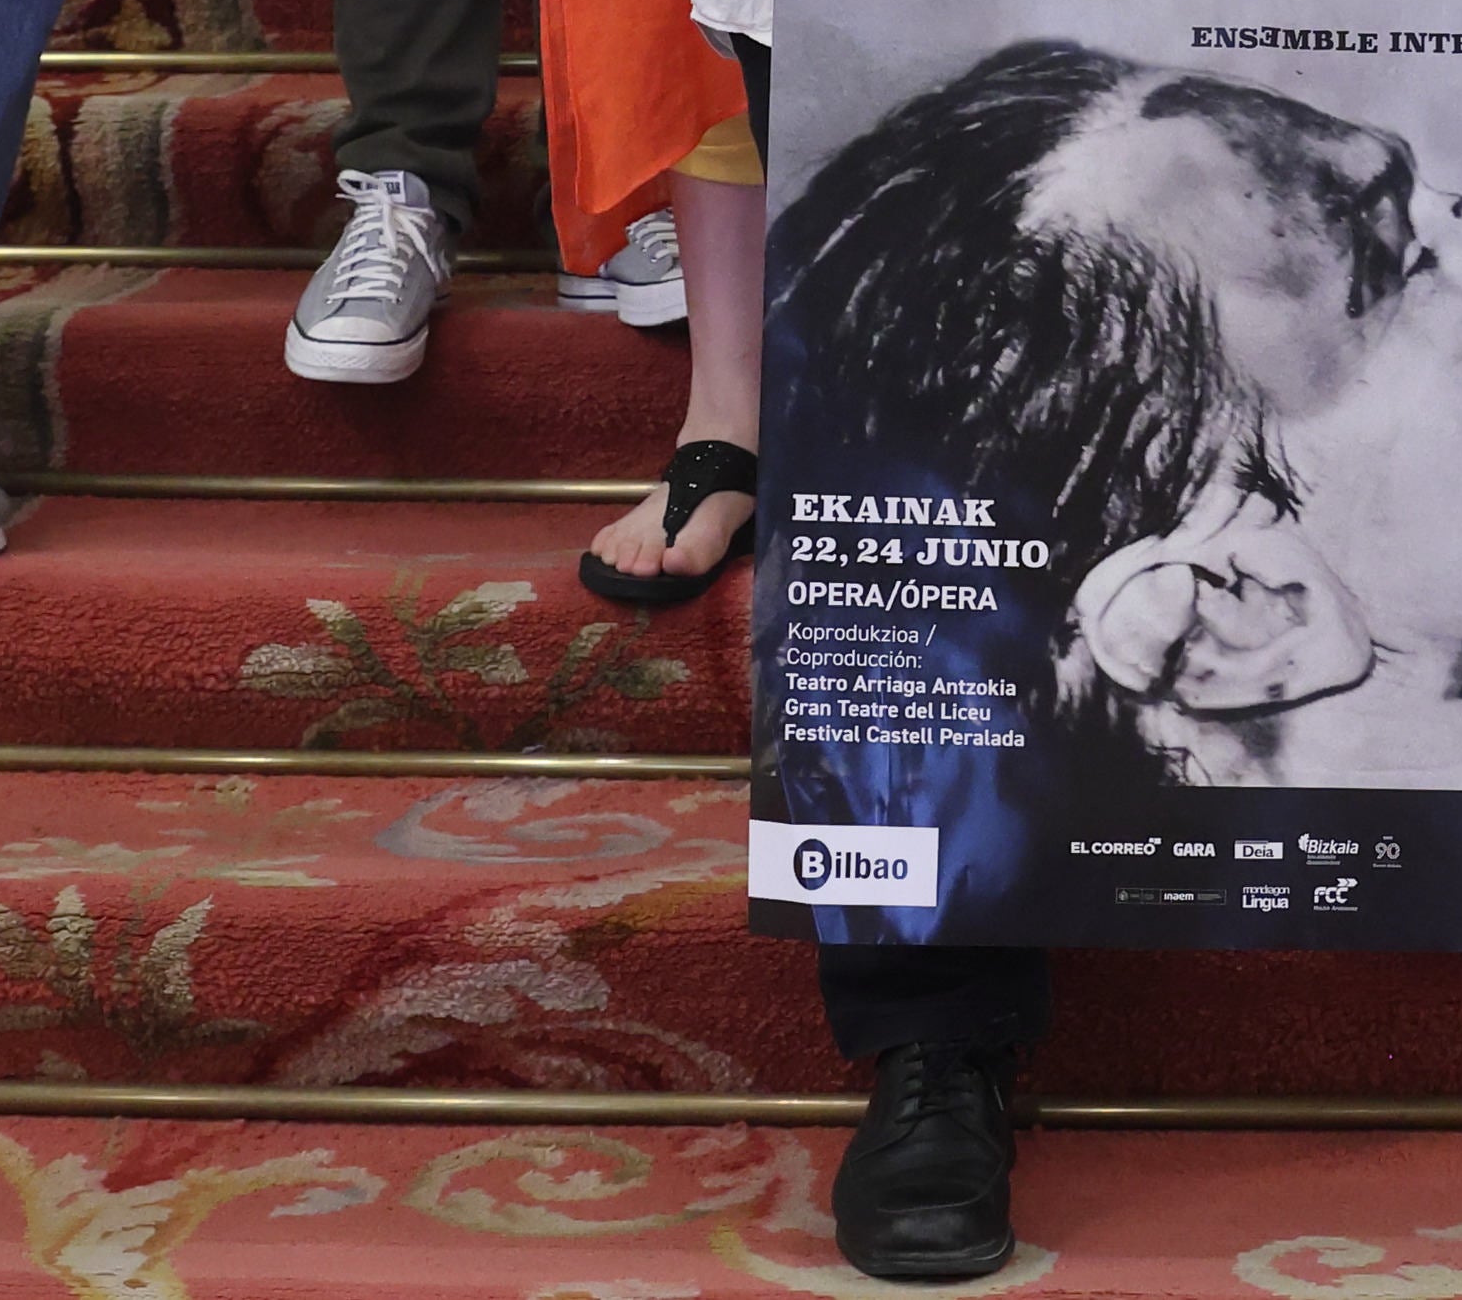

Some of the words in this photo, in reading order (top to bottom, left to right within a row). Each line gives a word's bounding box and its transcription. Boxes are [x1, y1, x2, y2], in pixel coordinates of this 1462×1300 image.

[792, 493, 996, 527] EKAINAK
[791, 536, 849, 567] 22,
[856, 538, 904, 565] 24
[916, 537, 1050, 569] JUNIO
[787, 579, 998, 612] OPERA/ÓPERA
[788, 623, 919, 644] Koprodukzioa
[786, 648, 922, 670] Coproducción:
[785, 672, 847, 691] Teatro
[852, 675, 926, 697] Arriaga
[932, 677, 1017, 697] Antzokia
[785, 699, 831, 717] Gran
[837, 699, 899, 719] Teatre
[904, 701, 934, 720] del
[941, 703, 991, 721] Liceu
[784, 723, 860, 743] Festival
[866, 725, 934, 745] Castell
[939, 727, 1025, 747] Peralada
[1070, 841, 1090, 855] EL
[1091, 841, 1156, 856] CORREO
[1172, 842, 1216, 857] GARA
[1242, 845, 1275, 859] Deia
[1307, 839, 1359, 855] Bizkaia
[798, 847, 908, 881] Bilbao
[1242, 894, 1289, 912] Lingua
[1313, 886, 1349, 904] FCC
